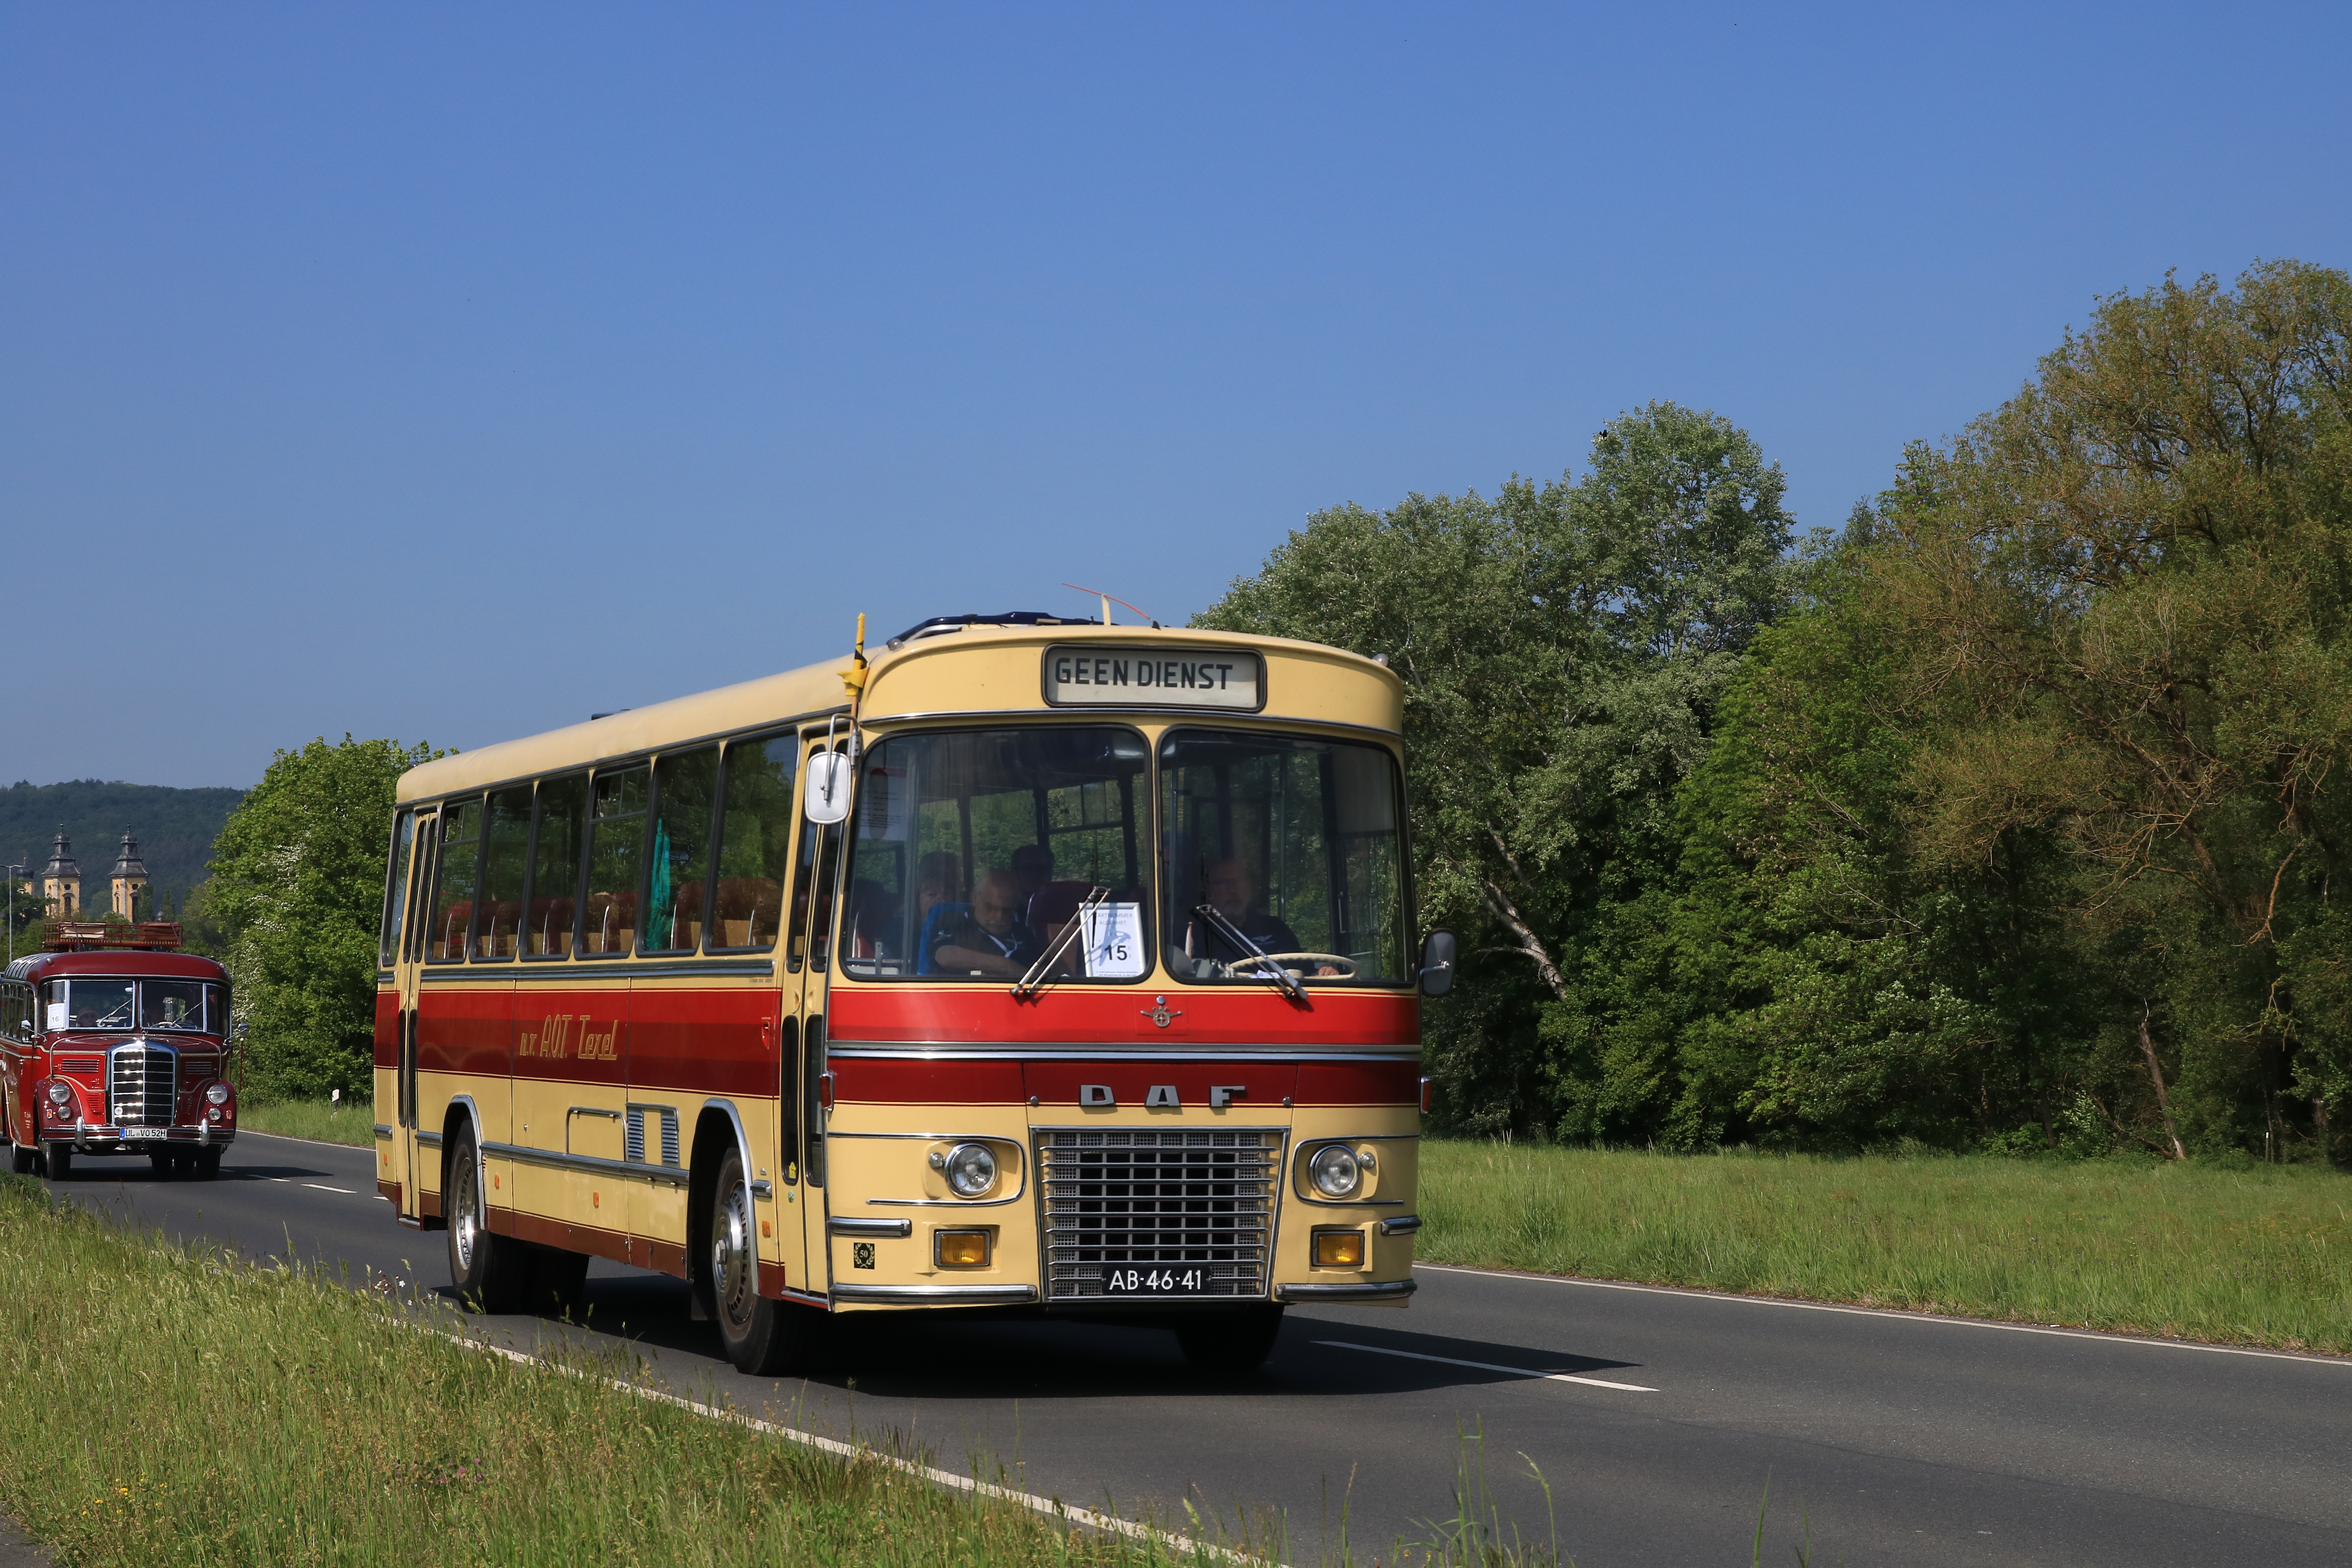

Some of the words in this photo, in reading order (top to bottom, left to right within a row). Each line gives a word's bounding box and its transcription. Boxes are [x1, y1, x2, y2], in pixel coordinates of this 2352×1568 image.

[1055, 657, 1128, 686] GEEN
[1137, 660, 1233, 690] DIENST
[1104, 945, 1127, 960] 15
[577, 1015, 618, 1060] Texel
[1080, 1084, 1245, 1107] DAF
[1109, 1270, 1201, 1290] AB-46-41
